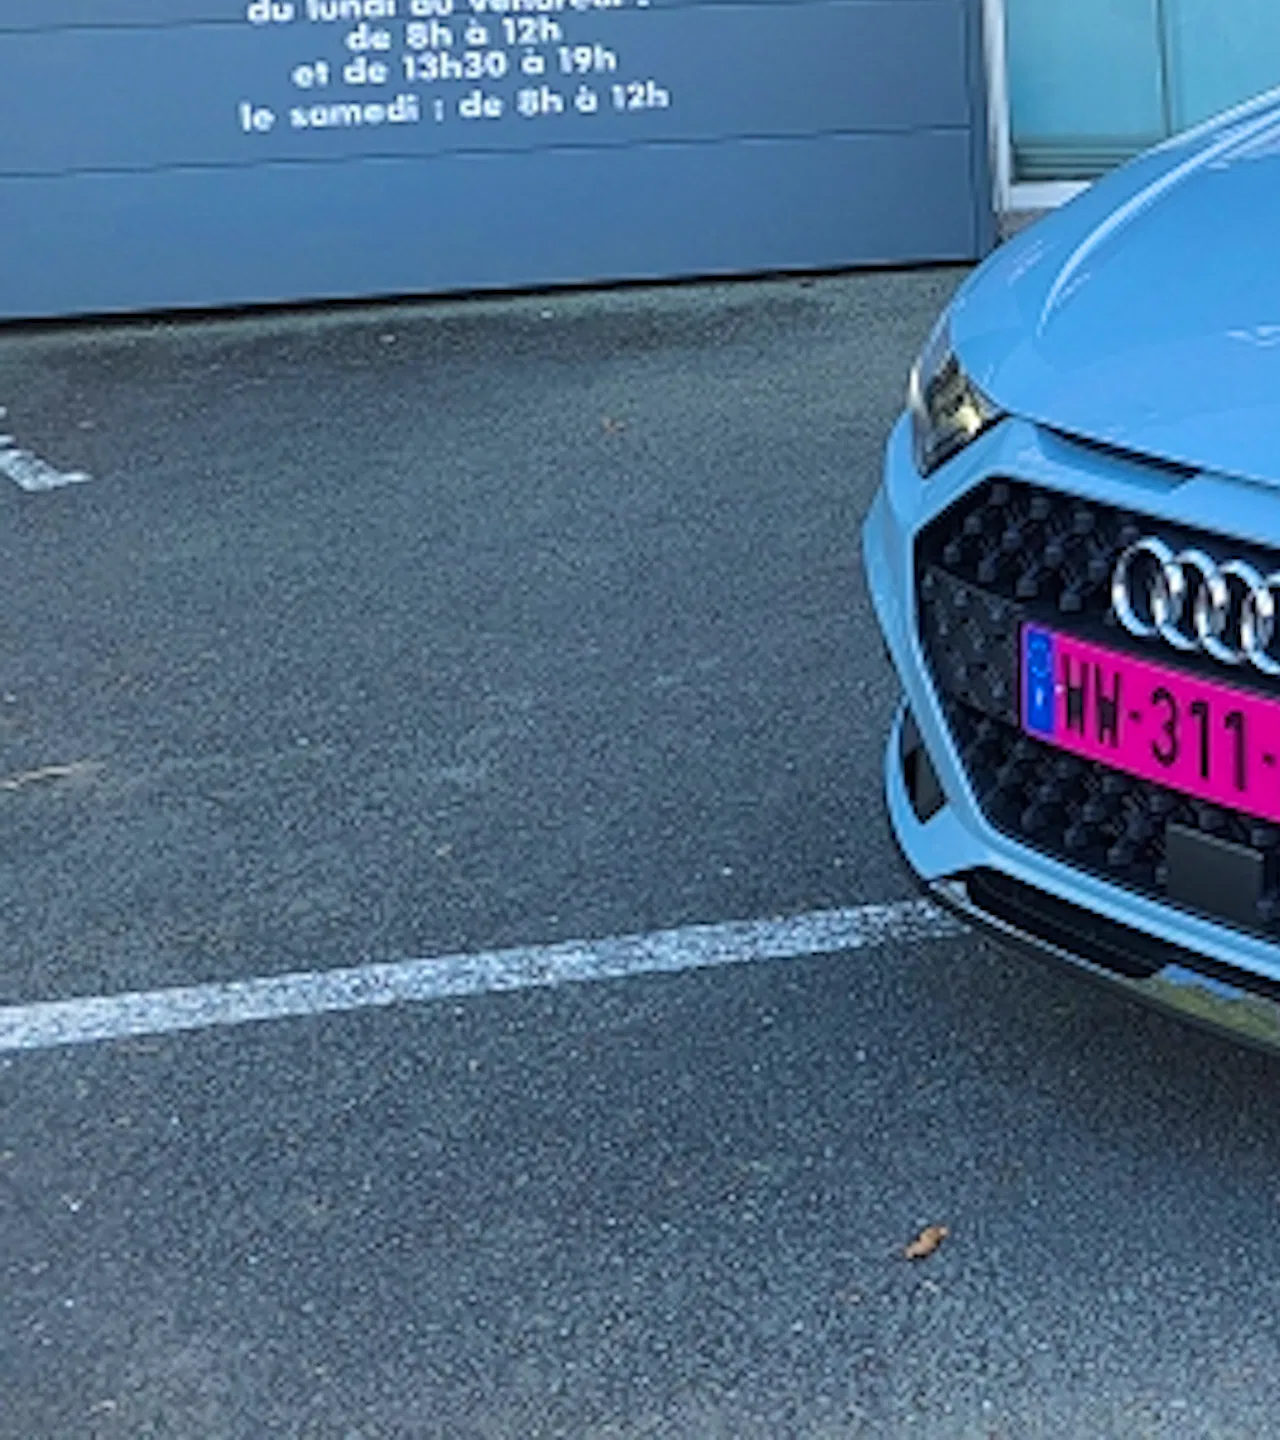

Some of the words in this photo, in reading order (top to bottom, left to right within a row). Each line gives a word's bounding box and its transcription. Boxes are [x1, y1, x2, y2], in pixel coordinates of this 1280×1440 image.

[345, 23, 391, 53] de
[405, 20, 452, 49] 8h
[464, 17, 489, 47] à
[502, 17, 563, 45] 12h
[291, 61, 329, 89] et
[342, 57, 389, 86] de
[402, 50, 507, 81] 13h30
[521, 48, 546, 76] à
[558, 45, 617, 74] 19h
[239, 102, 275, 134] le
[290, 94, 420, 129] samedi
[458, 89, 503, 119] de
[517, 86, 564, 116] 8h
[574, 85, 599, 113] à
[611, 80, 670, 110] 12h
